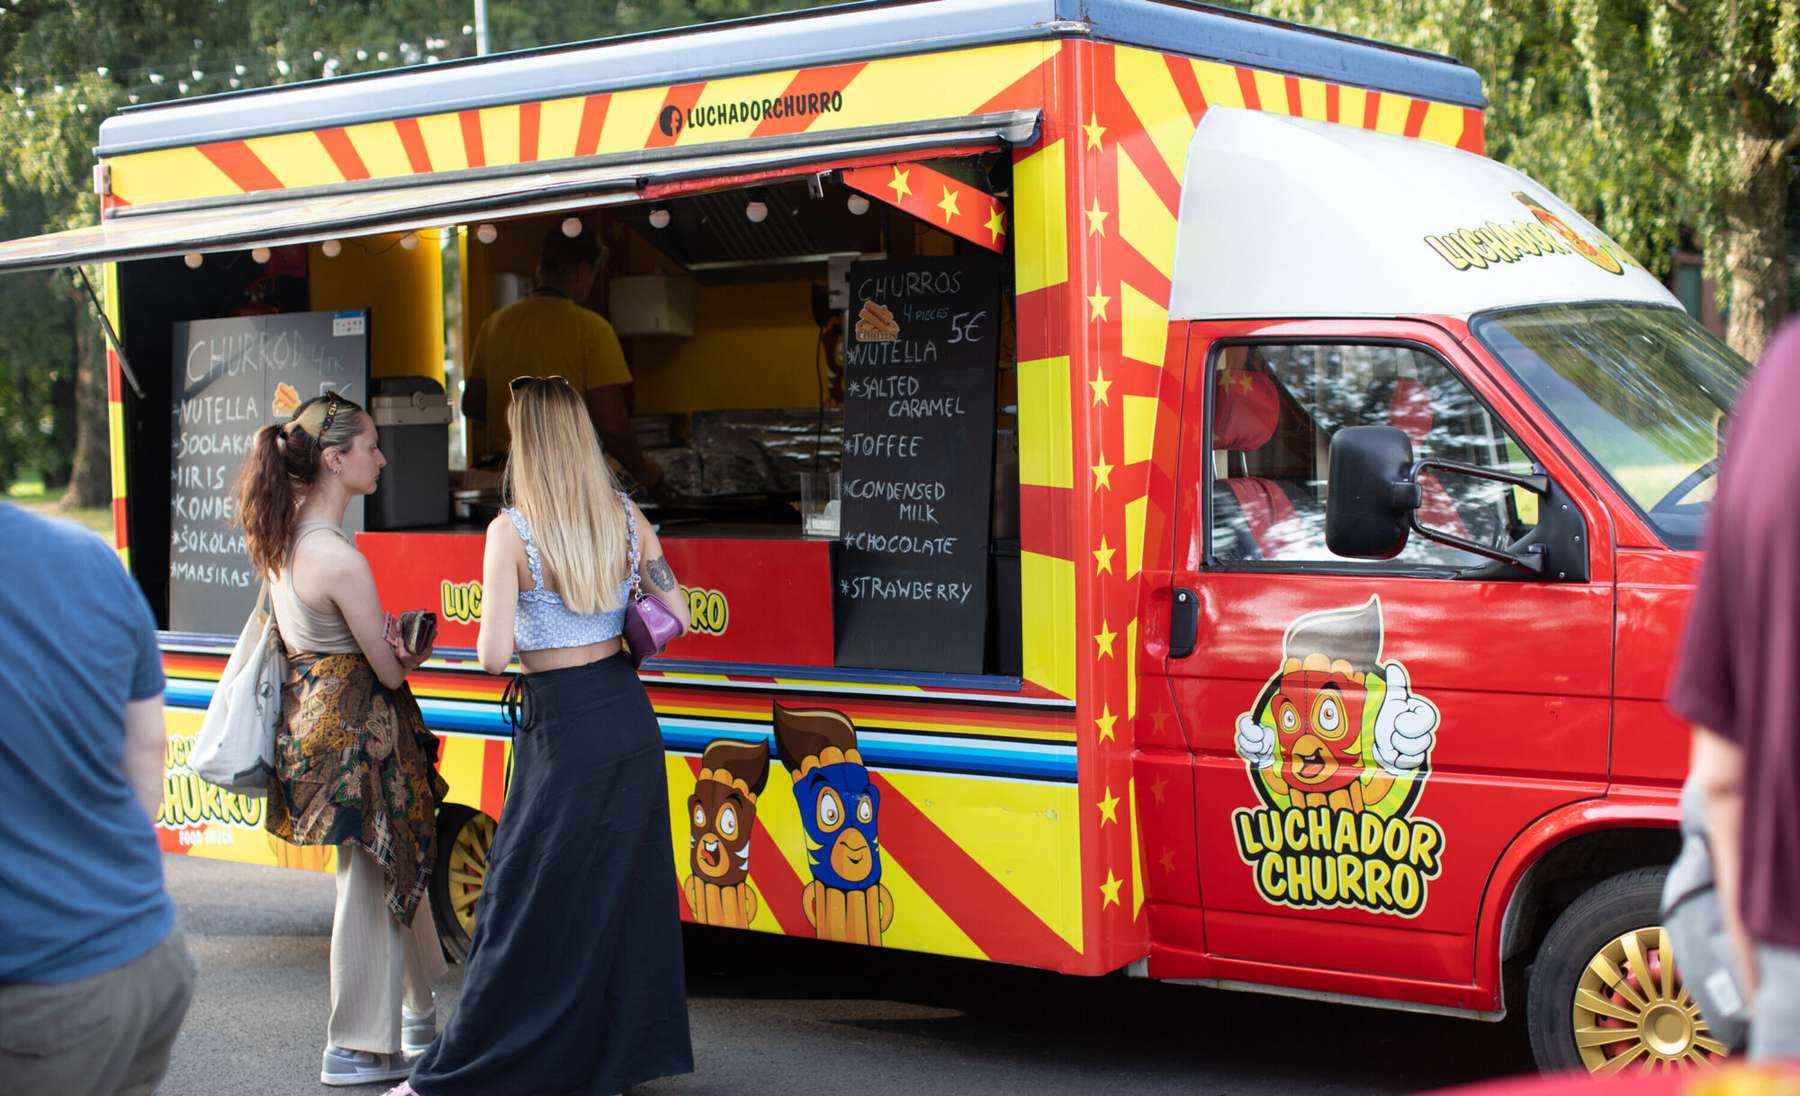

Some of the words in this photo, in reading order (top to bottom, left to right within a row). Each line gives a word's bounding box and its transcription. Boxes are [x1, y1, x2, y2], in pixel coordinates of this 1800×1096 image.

[687, 90, 843, 129] LUCHADORCHURRO
[858, 272, 962, 301] CHURROS
[903, 303, 912, 323] 4
[915, 306, 950, 321] PIECES
[948, 311, 987, 344] 5€
[889, 397, 966, 419] CARAMEL
[850, 479, 946, 500] CONDENSED
[899, 503, 939, 524] MILK
[856, 532, 958, 556] CHOCOLATE
[852, 576, 972, 604] STRAWBERRY
[1239, 807, 1439, 870] LUCHADOR
[1261, 852, 1420, 910] CHURRO
